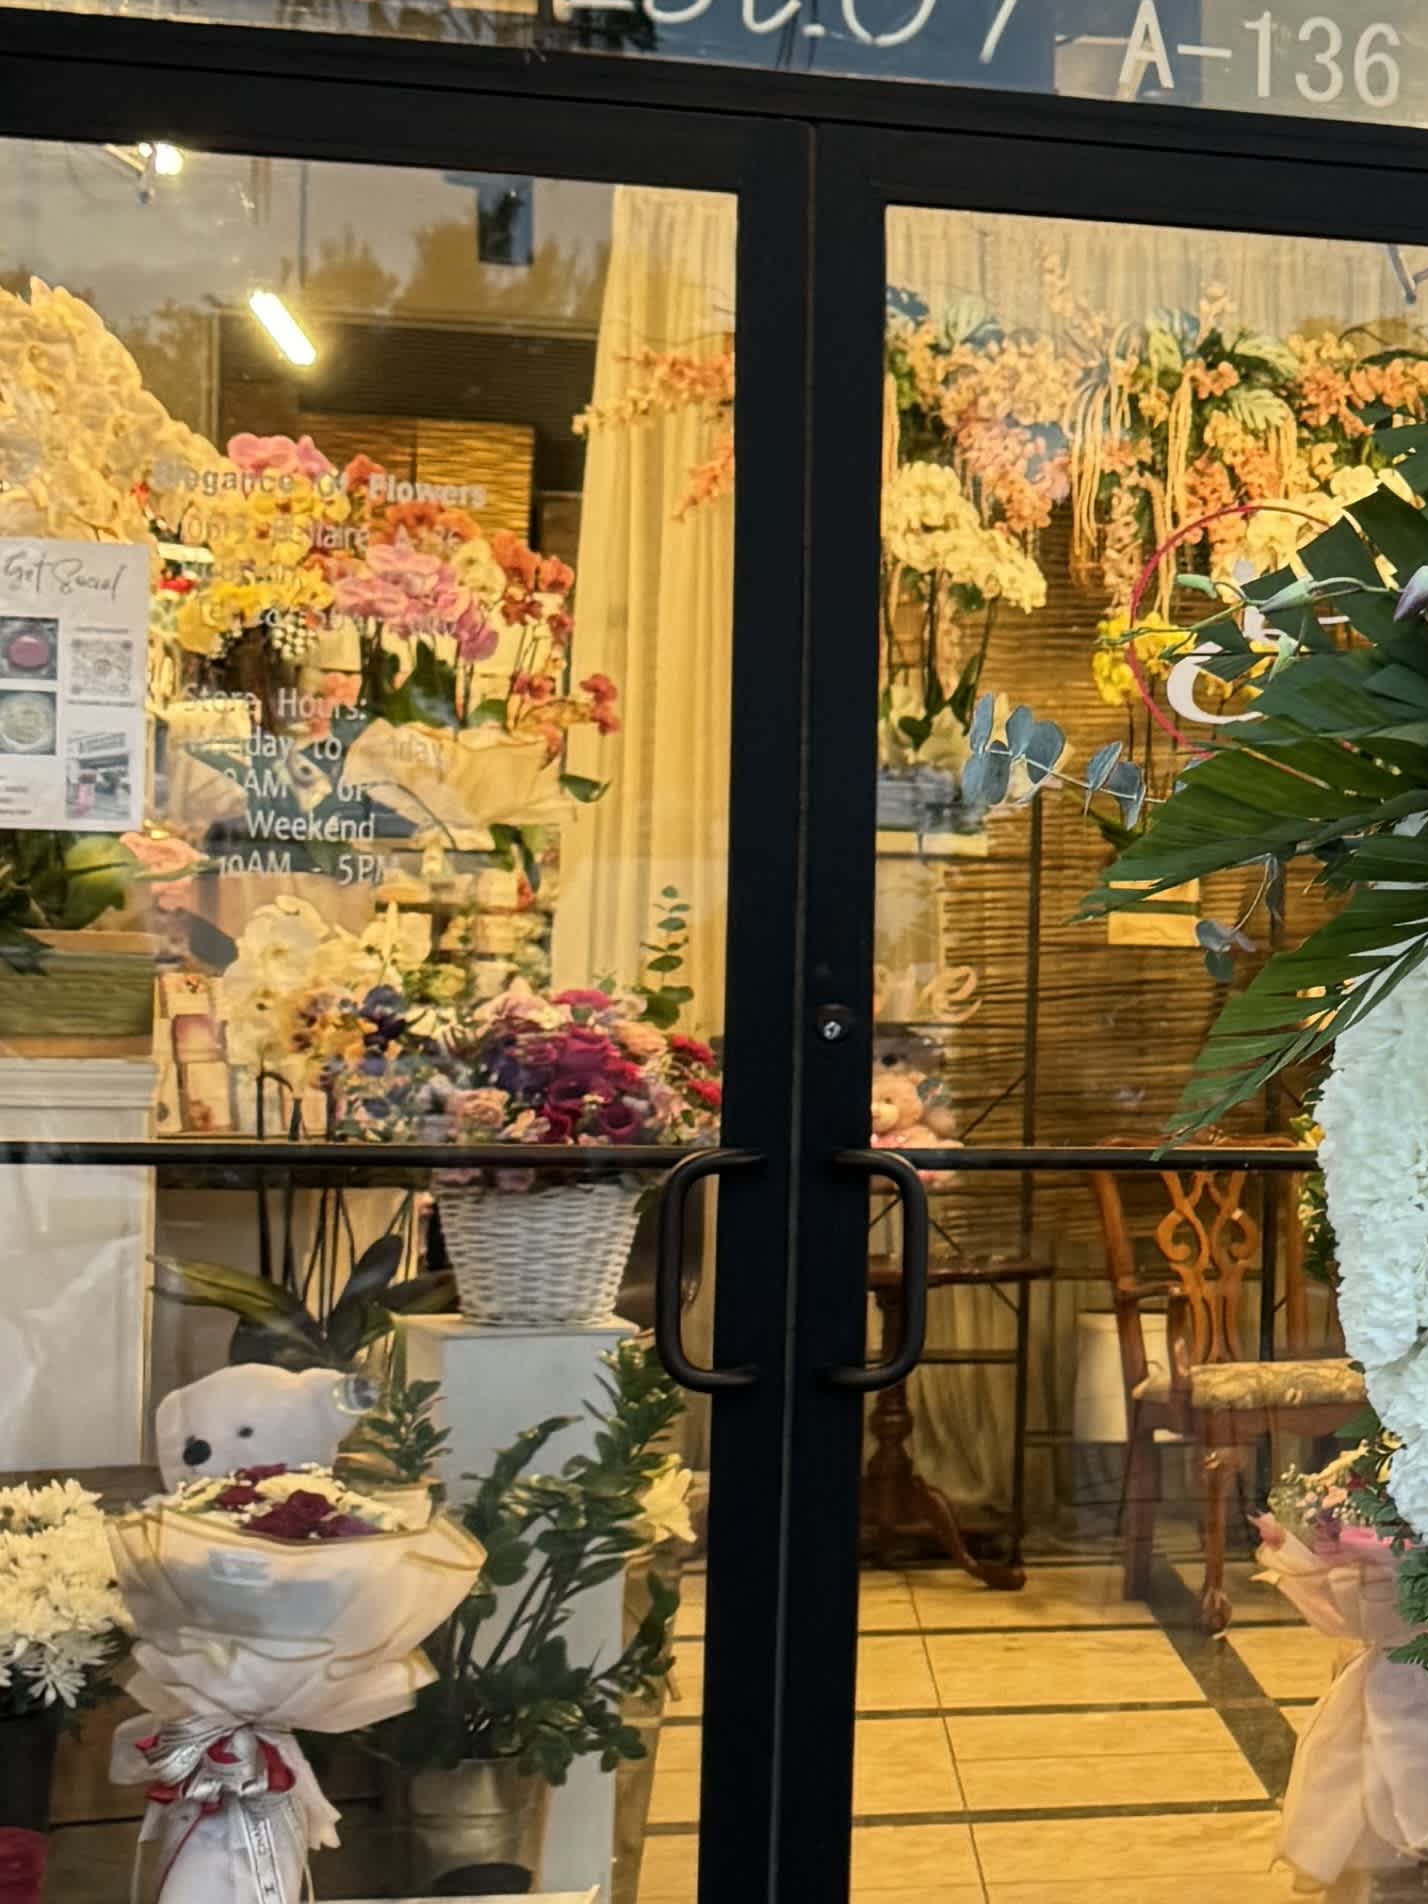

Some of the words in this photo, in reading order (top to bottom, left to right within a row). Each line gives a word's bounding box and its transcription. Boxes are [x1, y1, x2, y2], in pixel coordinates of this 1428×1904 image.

[369, 474, 488, 509] Flowers
[278, 687, 367, 721] Hours:
[313, 738, 342, 761] to
[246, 809, 376, 842] Weekend
